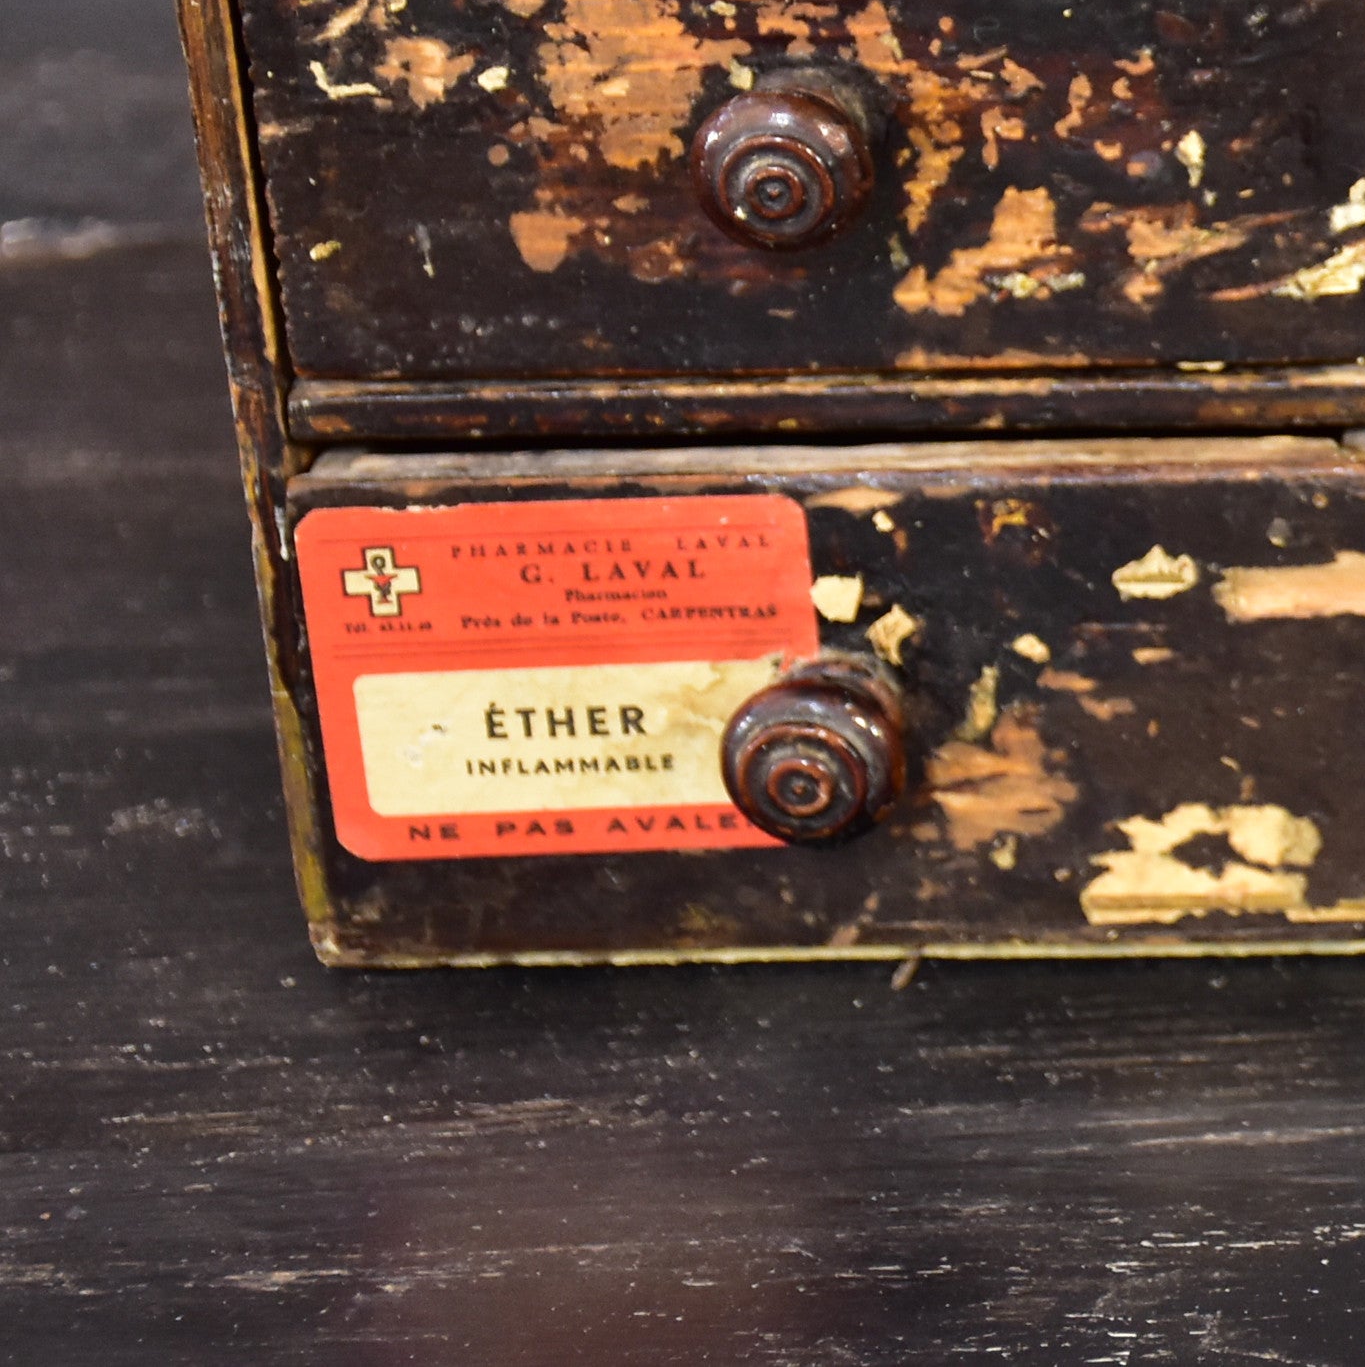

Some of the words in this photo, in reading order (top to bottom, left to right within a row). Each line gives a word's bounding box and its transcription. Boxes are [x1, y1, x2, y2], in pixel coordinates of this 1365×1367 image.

[451, 538, 632, 559] PHARMACIE
[676, 534, 769, 551] LAVAL
[581, 559, 706, 582] LAVAL
[564, 589, 668, 603] Pharmacien
[510, 613, 533, 628] de
[543, 611, 560, 626] la
[640, 602, 778, 622] CARPENTRAS
[485, 702, 648, 741] ÉTHER
[465, 752, 676, 777] INFLAMMABLE
[408, 822, 461, 842] NE
[494, 817, 575, 838] PAS
[606, 811, 755, 834] AVALE
